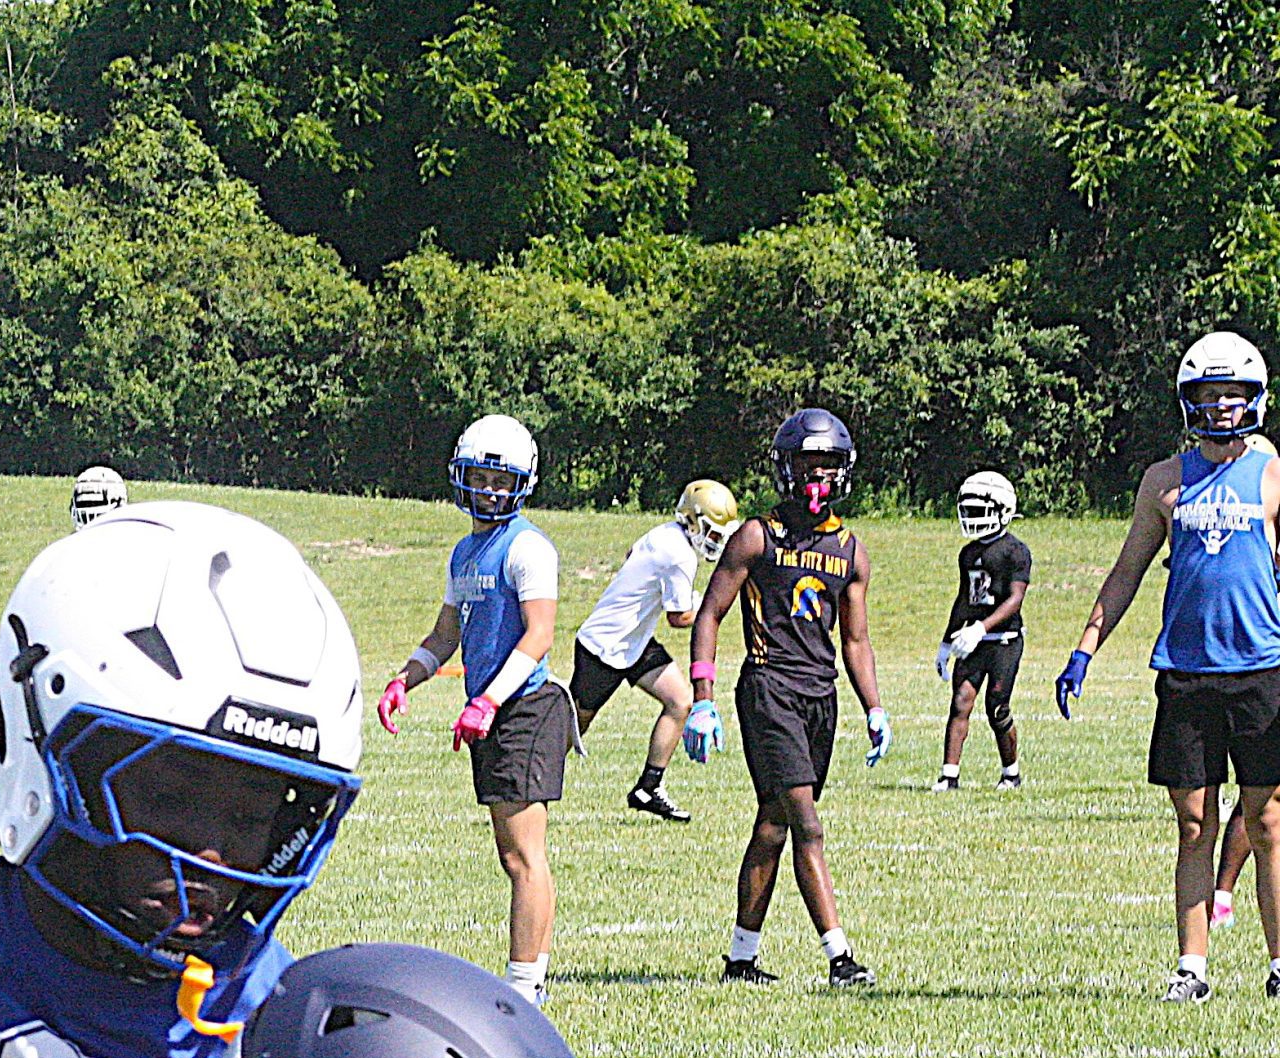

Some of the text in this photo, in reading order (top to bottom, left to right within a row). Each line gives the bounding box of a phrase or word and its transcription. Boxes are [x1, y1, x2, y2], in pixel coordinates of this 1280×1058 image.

[775, 547, 849, 578] THE FITZ WAY
[222, 705, 318, 753] Riddell
